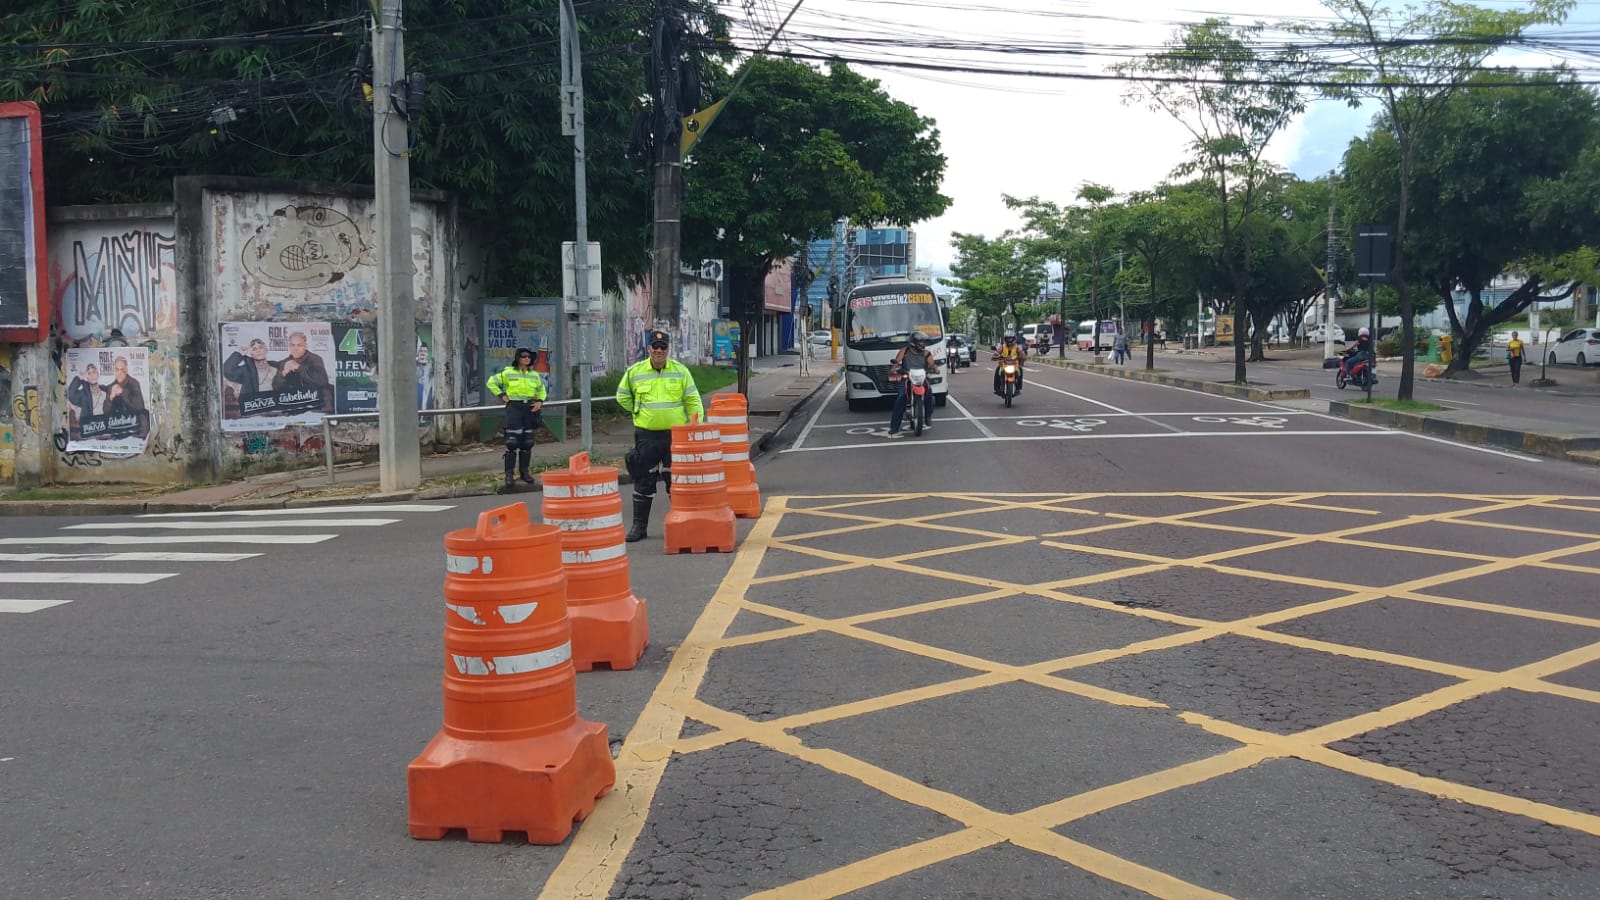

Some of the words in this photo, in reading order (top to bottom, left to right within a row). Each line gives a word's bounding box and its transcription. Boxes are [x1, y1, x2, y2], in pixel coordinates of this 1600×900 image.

[908, 293, 933, 305] CENTRO
[488, 319, 517, 329] NESSA
[488, 339, 504, 348] VAI
[505, 339, 518, 348] DE
[345, 360, 367, 370] FEV
[244, 398, 276, 410] PAIVA
[83, 420, 107, 433] PAIVA
